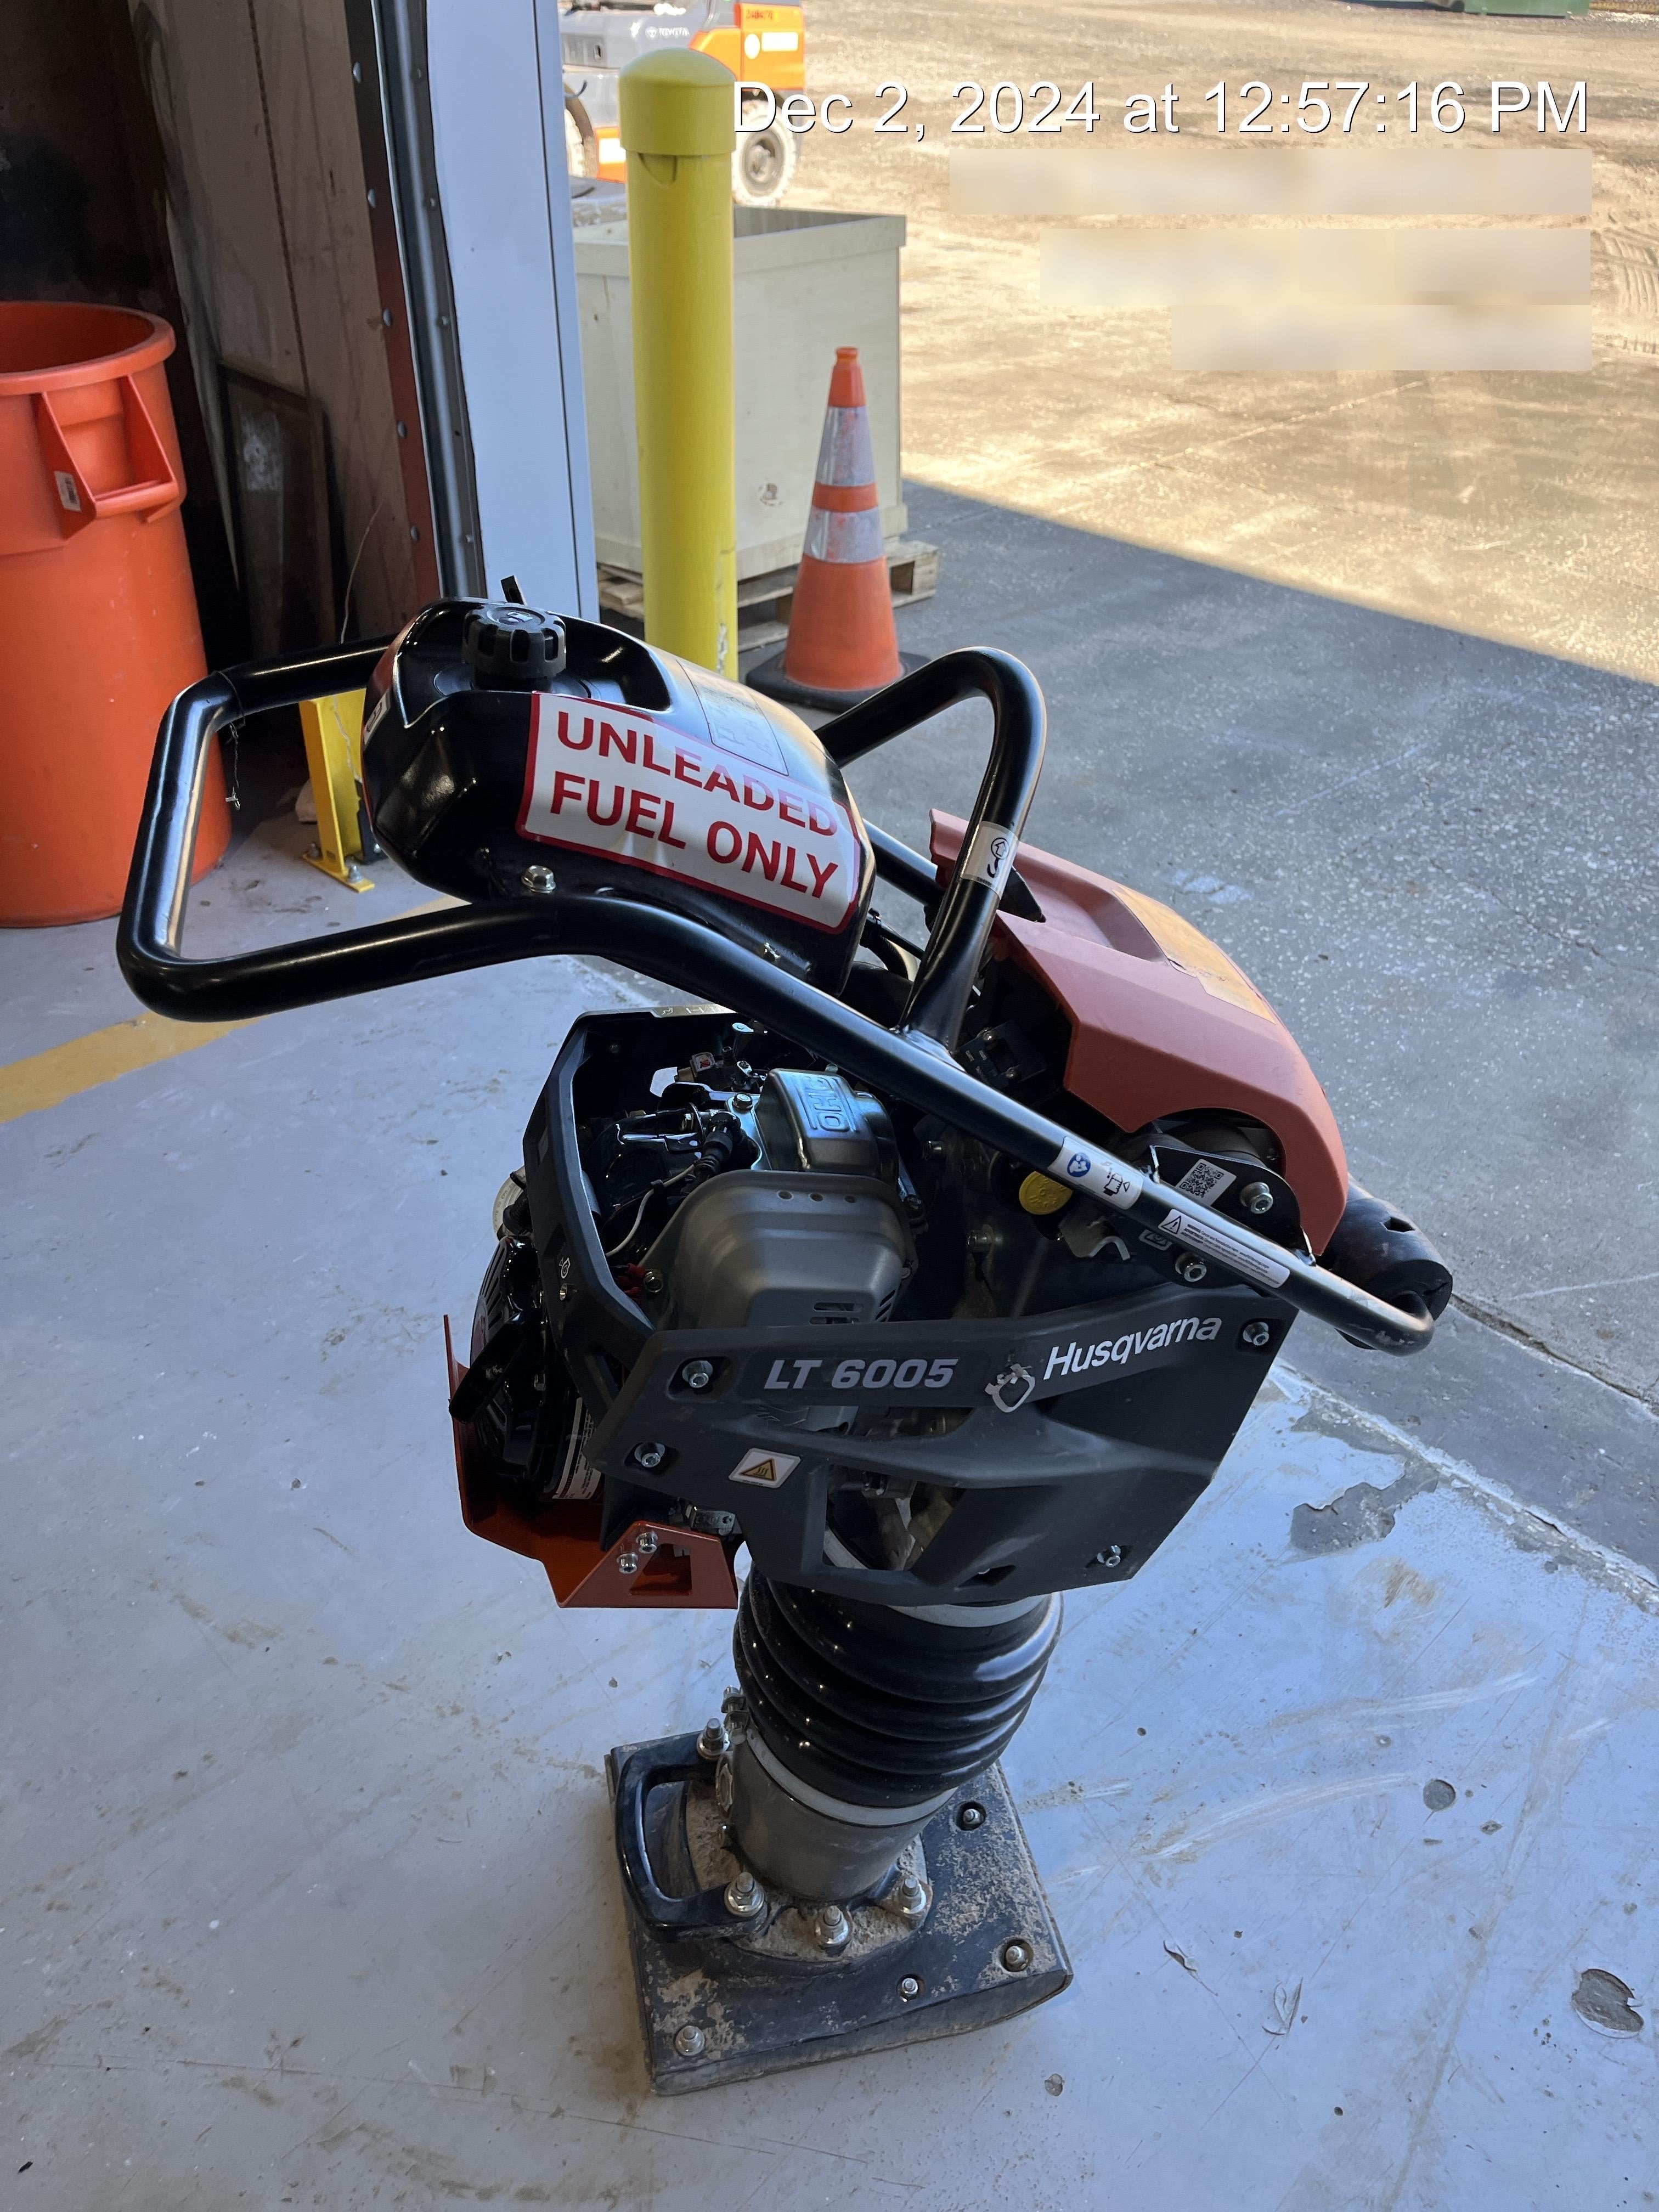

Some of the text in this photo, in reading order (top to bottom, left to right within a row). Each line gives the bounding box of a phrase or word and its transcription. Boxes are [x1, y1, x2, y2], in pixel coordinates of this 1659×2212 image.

[558, 711, 838, 837] UNLEADED
[550, 771, 839, 899] FUEL ONLY
[764, 1358, 959, 1389] LT 6005
[1043, 1317, 1222, 1380] Husqvarna
